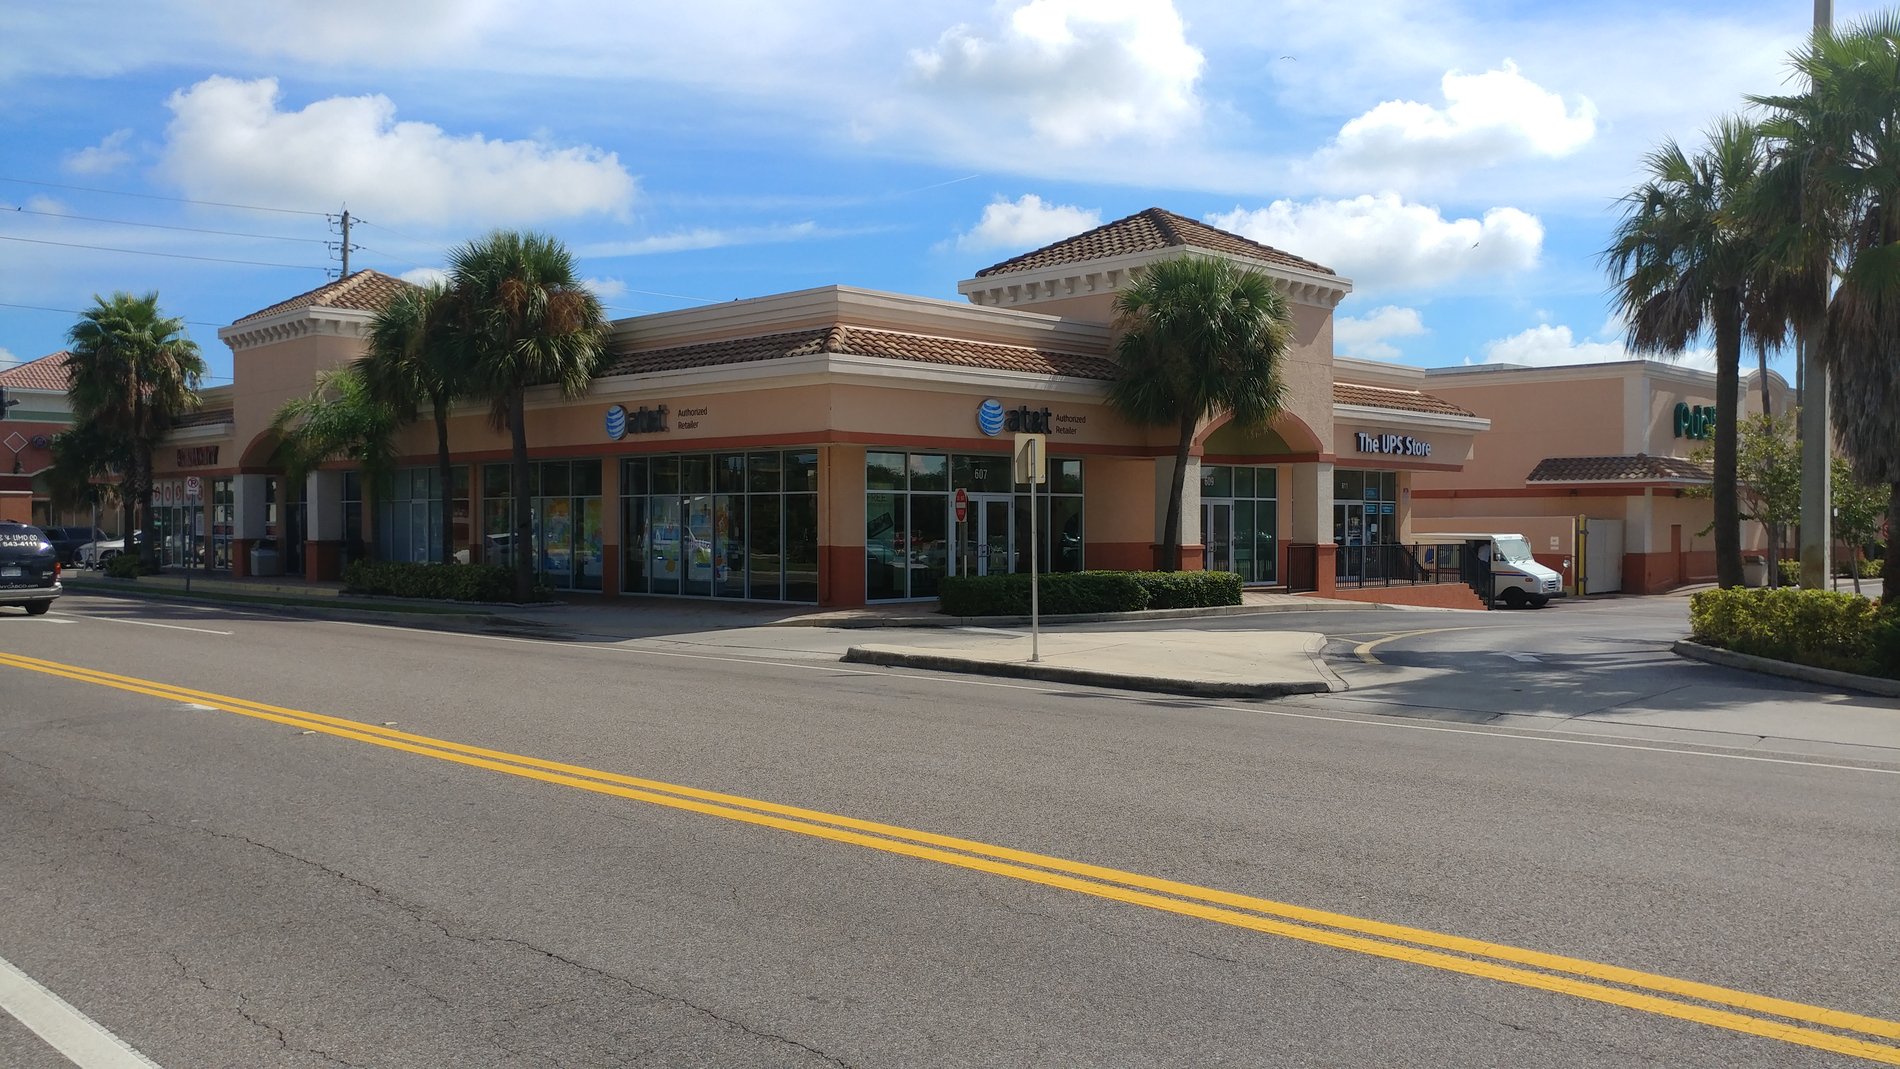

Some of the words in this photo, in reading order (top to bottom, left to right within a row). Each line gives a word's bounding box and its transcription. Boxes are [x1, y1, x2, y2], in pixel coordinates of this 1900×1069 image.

[677, 406, 708, 418] Authorized
[1055, 414, 1086, 424] Authorized
[677, 420, 699, 430] Retailer
[1055, 425, 1077, 435] Retailer
[1357, 432, 1379, 453] The
[1381, 434, 1404, 454] UPS
[1405, 436, 1431, 456] Store
[974, 468, 988, 480] 607
